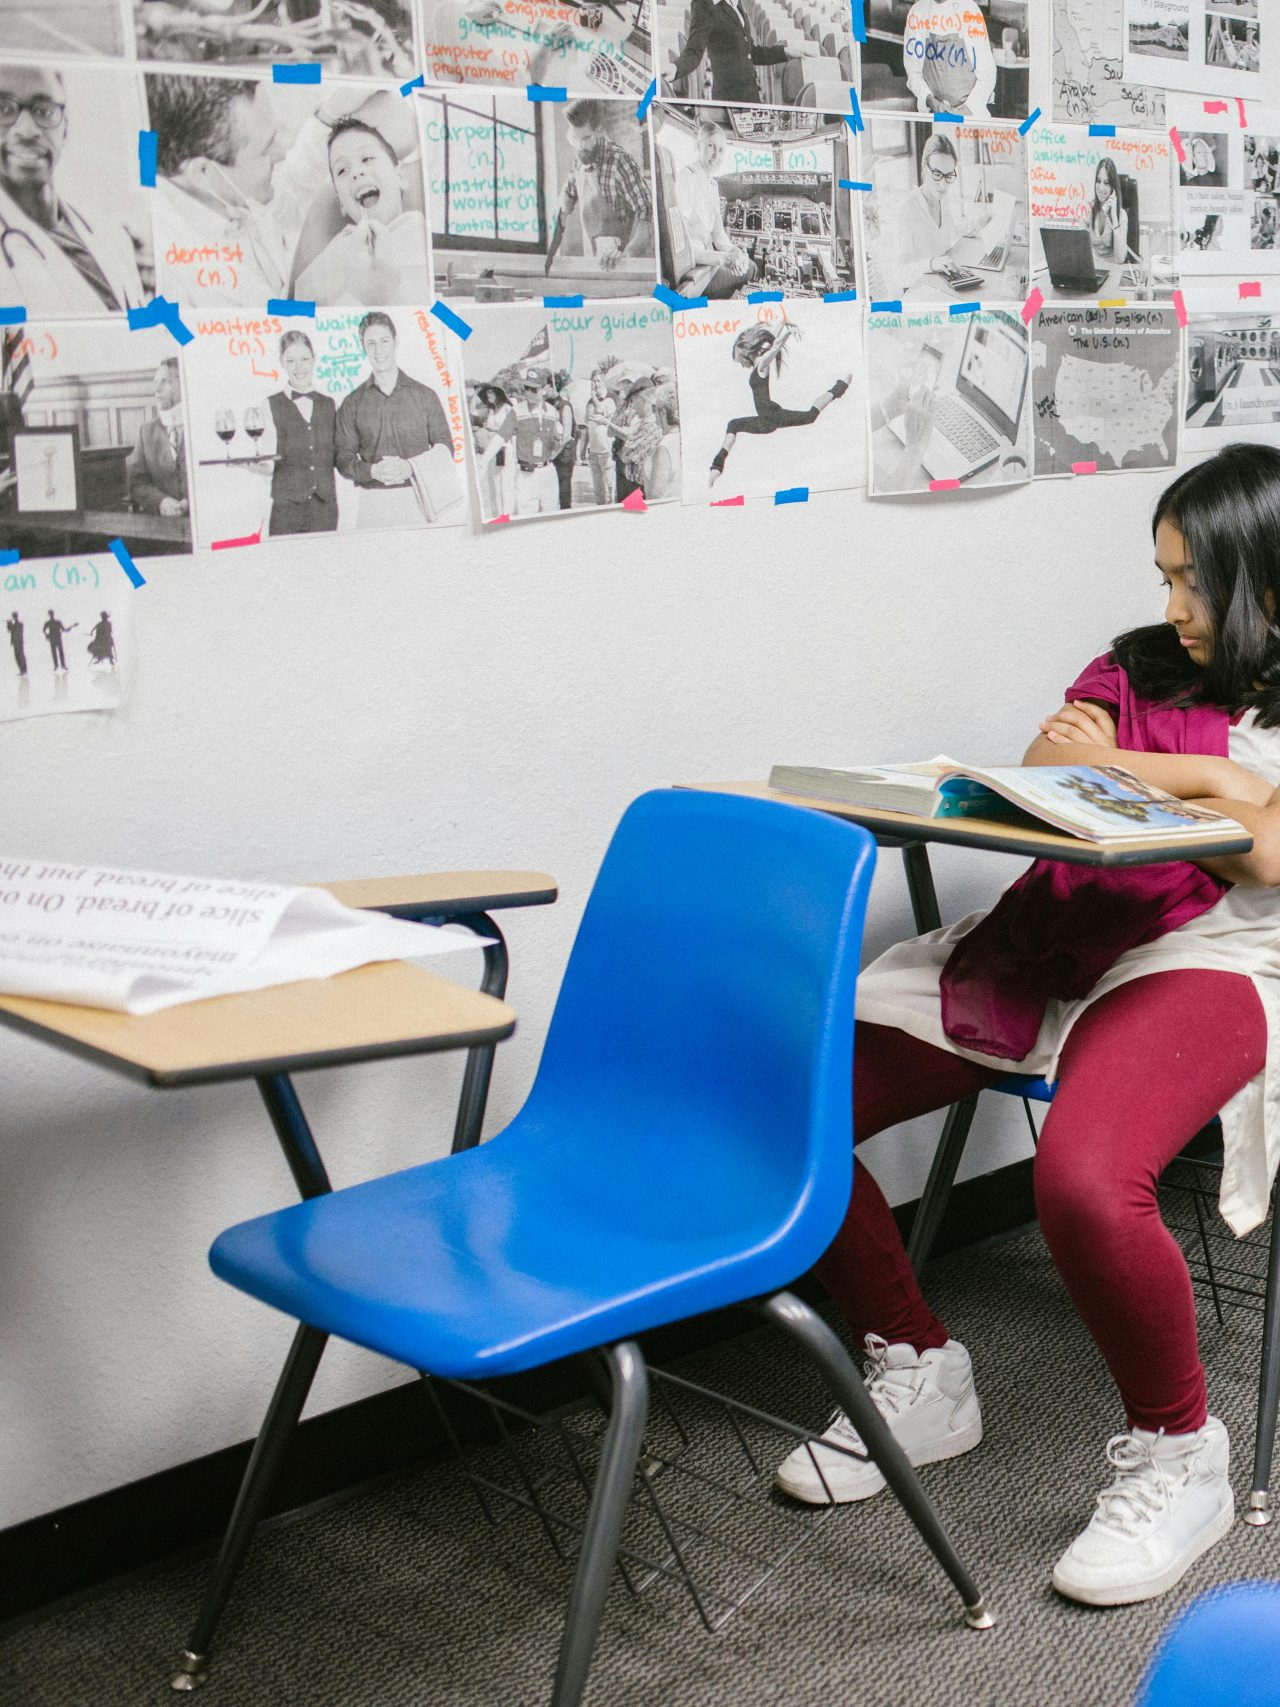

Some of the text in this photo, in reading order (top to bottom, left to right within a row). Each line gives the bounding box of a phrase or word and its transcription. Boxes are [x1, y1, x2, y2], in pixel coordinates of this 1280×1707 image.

[165, 242, 243, 265] dentist
[196, 265, 239, 289] (n.)
[197, 317, 283, 337] waitress
[550, 311, 594, 333] tour
[601, 311, 648, 341] guide
[675, 312, 741, 338] dancer
[907, 312, 943, 329] media
[1039, 311, 1084, 327] American
[1115, 310, 1147, 327] English
[1080, 326, 1172, 335] The United States of America
[228, 337, 266, 358] (n.)
[52, 560, 100, 589] (n.)
[159, 902, 194, 921] of
[199, 904, 264, 928] slice
